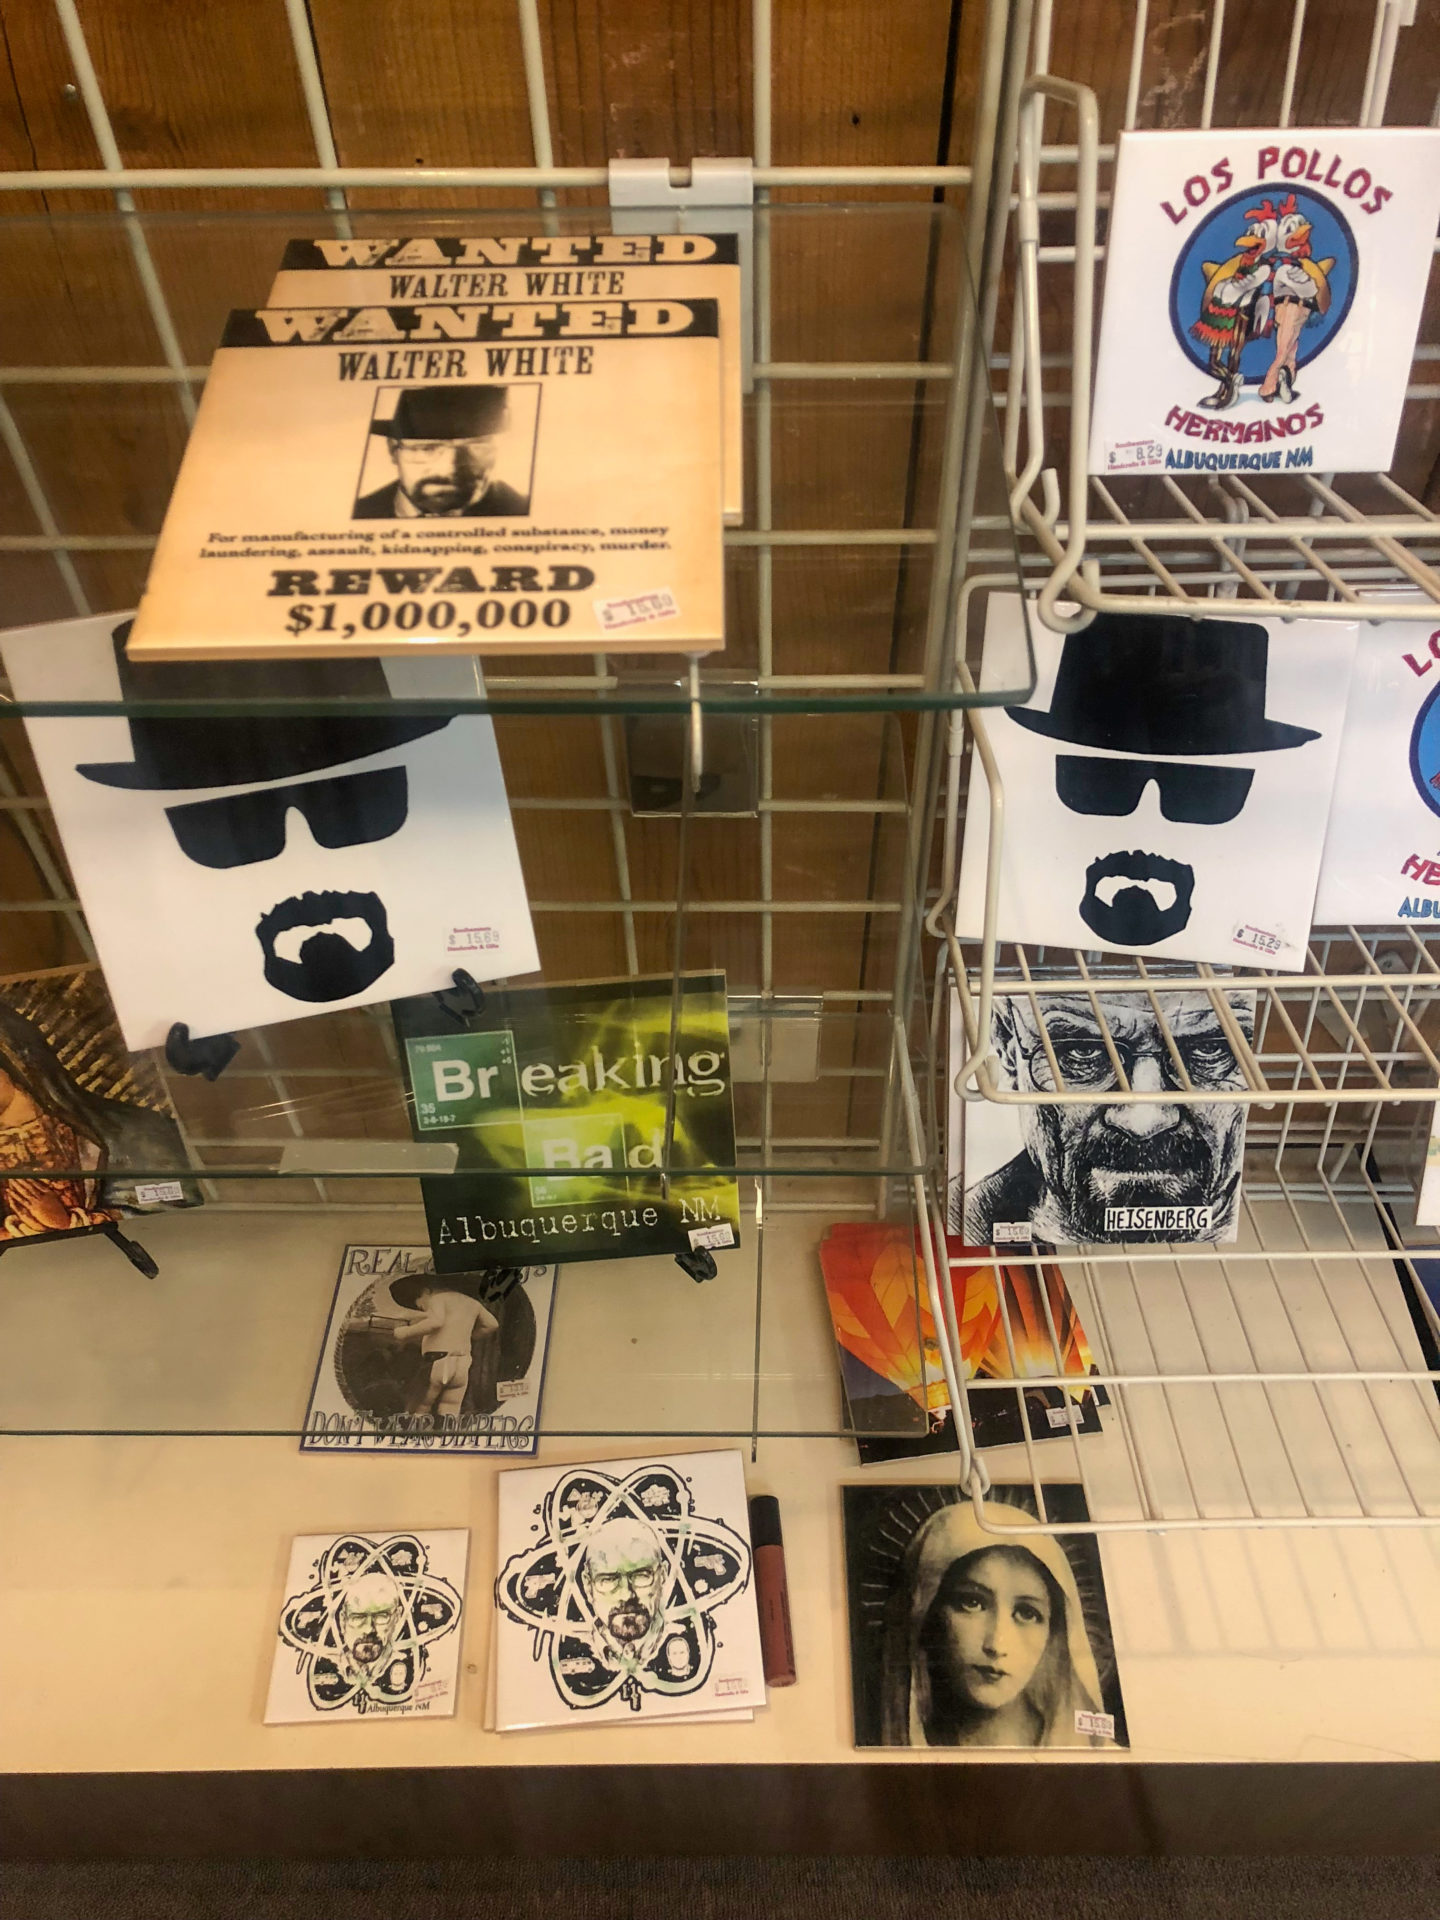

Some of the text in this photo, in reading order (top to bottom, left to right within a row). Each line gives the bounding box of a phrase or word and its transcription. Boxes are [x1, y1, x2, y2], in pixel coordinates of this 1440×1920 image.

[1160, 146, 1394, 225] LOS POLLOS
[313, 235, 717, 268] WANTED
[390, 271, 625, 299] WALTER WHITE
[255, 301, 694, 342] WANTED
[338, 346, 594, 380] WALTER WHITE
[1164, 402, 1325, 444] HERMANOS
[1165, 446, 1314, 471] ALBUQUERQUE NM
[200, 539, 671, 559] laundering, assault, kidnapping, conspiracy, murder.
[207, 532, 238, 543] For
[241, 529, 374, 542] manufacturing
[380, 529, 400, 539] of
[416, 527, 506, 539] controlled
[511, 525, 605, 538] substance,
[610, 526, 669, 537] money
[267, 564, 596, 597] REWARD
[285, 598, 572, 639] $1,000,000
[439, 1207, 659, 1245] Albuquerque
[679, 1195, 721, 1223] NM
[1107, 1208, 1208, 1229] HEISENBERG
[346, 1249, 418, 1276] REAL
[440, 1413, 535, 1450] DIAPERS
[367, 1702, 413, 1715] Albuquerque
